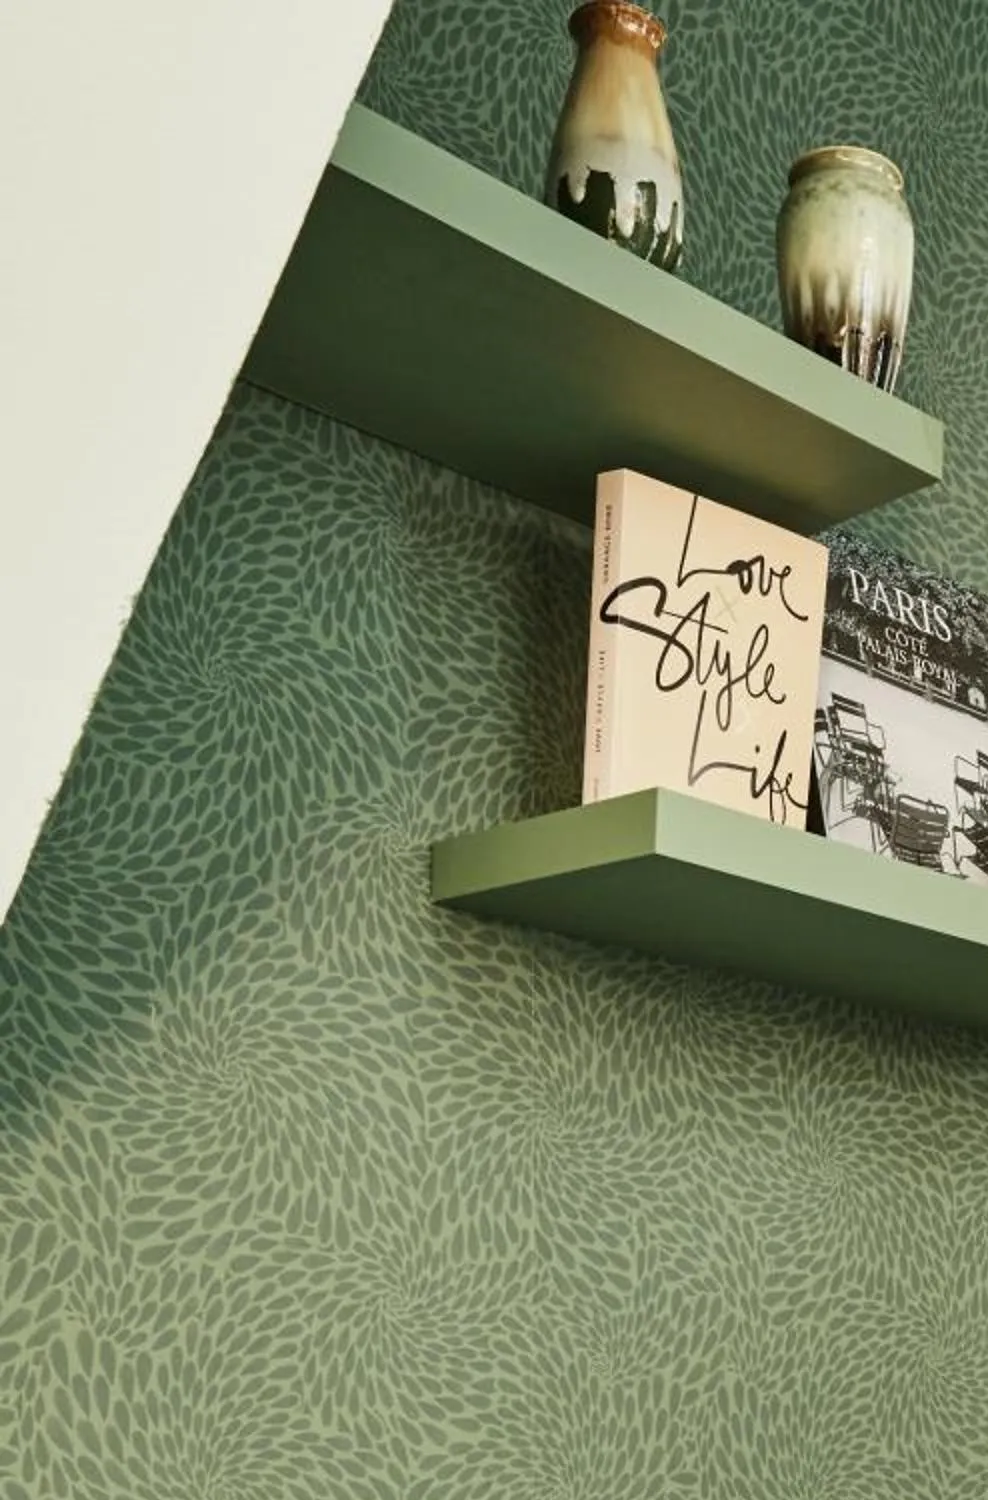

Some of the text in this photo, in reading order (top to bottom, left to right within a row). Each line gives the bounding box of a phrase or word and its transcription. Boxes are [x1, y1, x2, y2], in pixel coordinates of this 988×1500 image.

[677, 494, 808, 622] Love
[846, 567, 952, 643] PARIS
[600, 576, 786, 732] Style
[688, 688, 808, 827] Life
